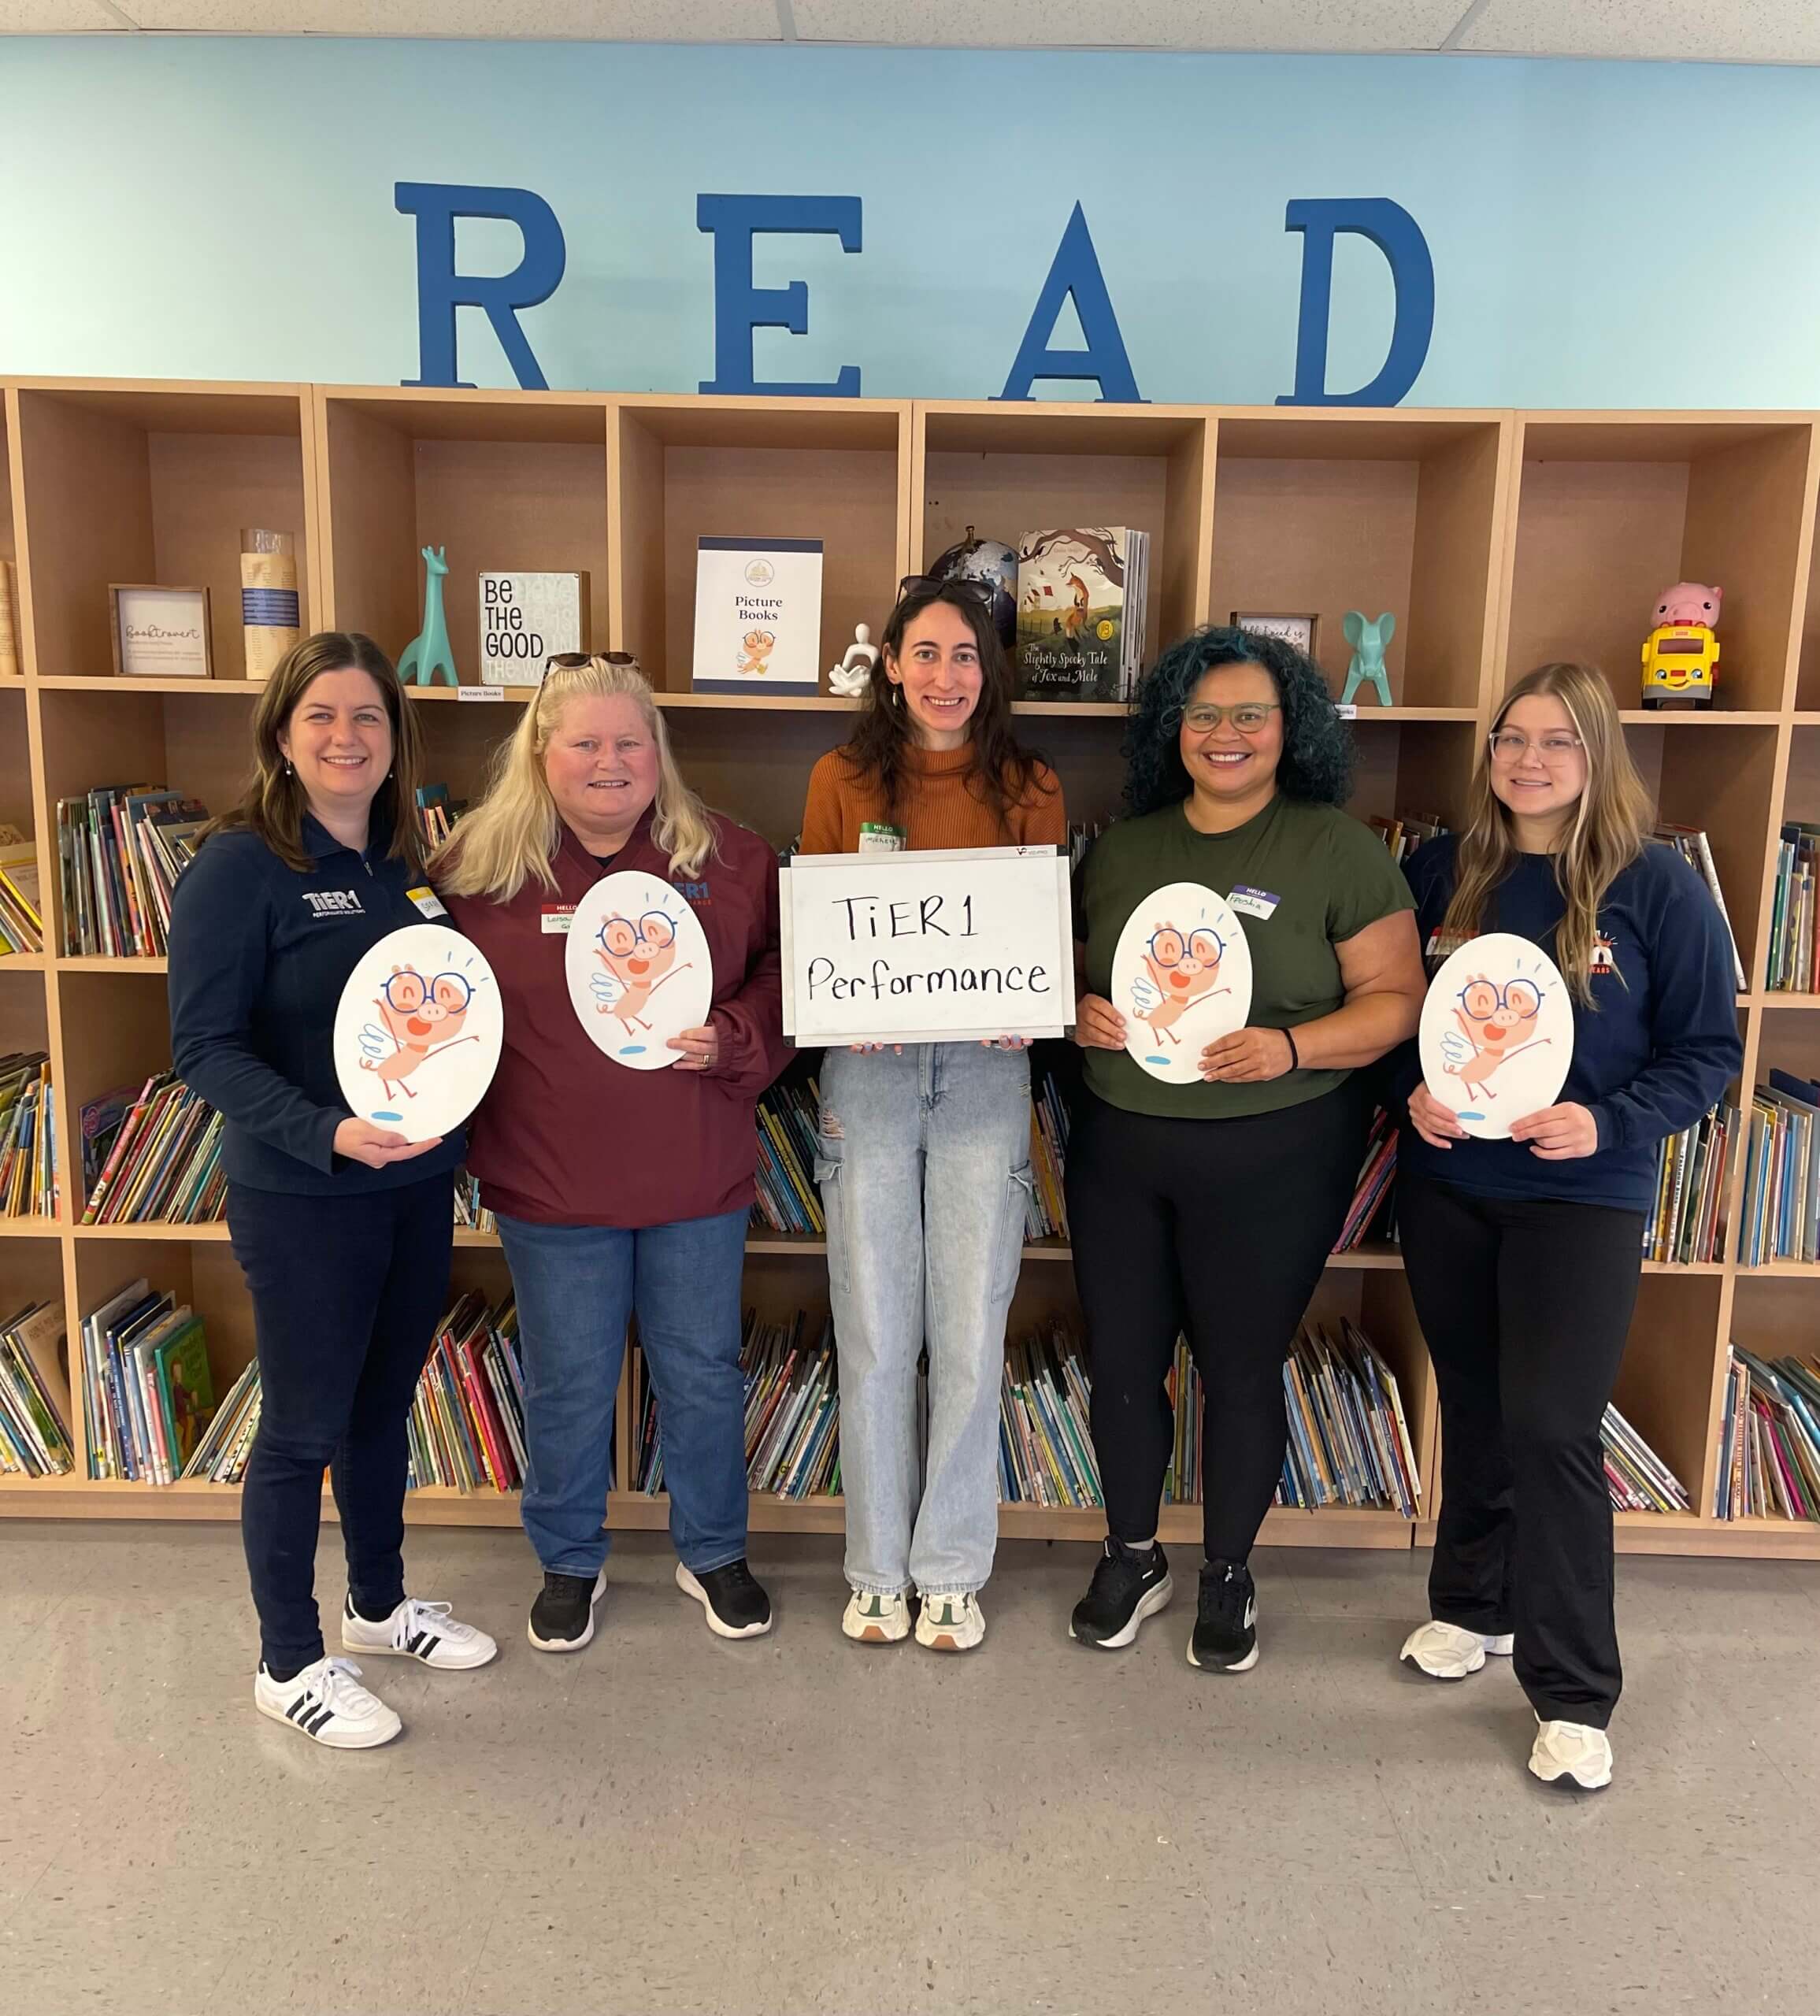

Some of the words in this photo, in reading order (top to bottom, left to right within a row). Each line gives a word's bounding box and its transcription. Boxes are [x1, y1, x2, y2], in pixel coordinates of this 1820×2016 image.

[395, 182, 1435, 407] READ
[735, 596, 783, 607] Picture
[739, 610, 778, 621] Books
[486, 632, 543, 658] GOOD
[1028, 643, 1040, 652] The
[1023, 652, 1057, 670] Slightly
[1058, 652, 1086, 669] Spooky
[1087, 650, 1108, 665] Tale
[1032, 673, 1039, 684] of
[1039, 669, 1057, 684] Fox
[1058, 673, 1071, 682] and
[1071, 668, 1099, 684] Mole
[1246, 888, 1267, 897] HELLO
[808, 957, 1051, 1000] Performance
